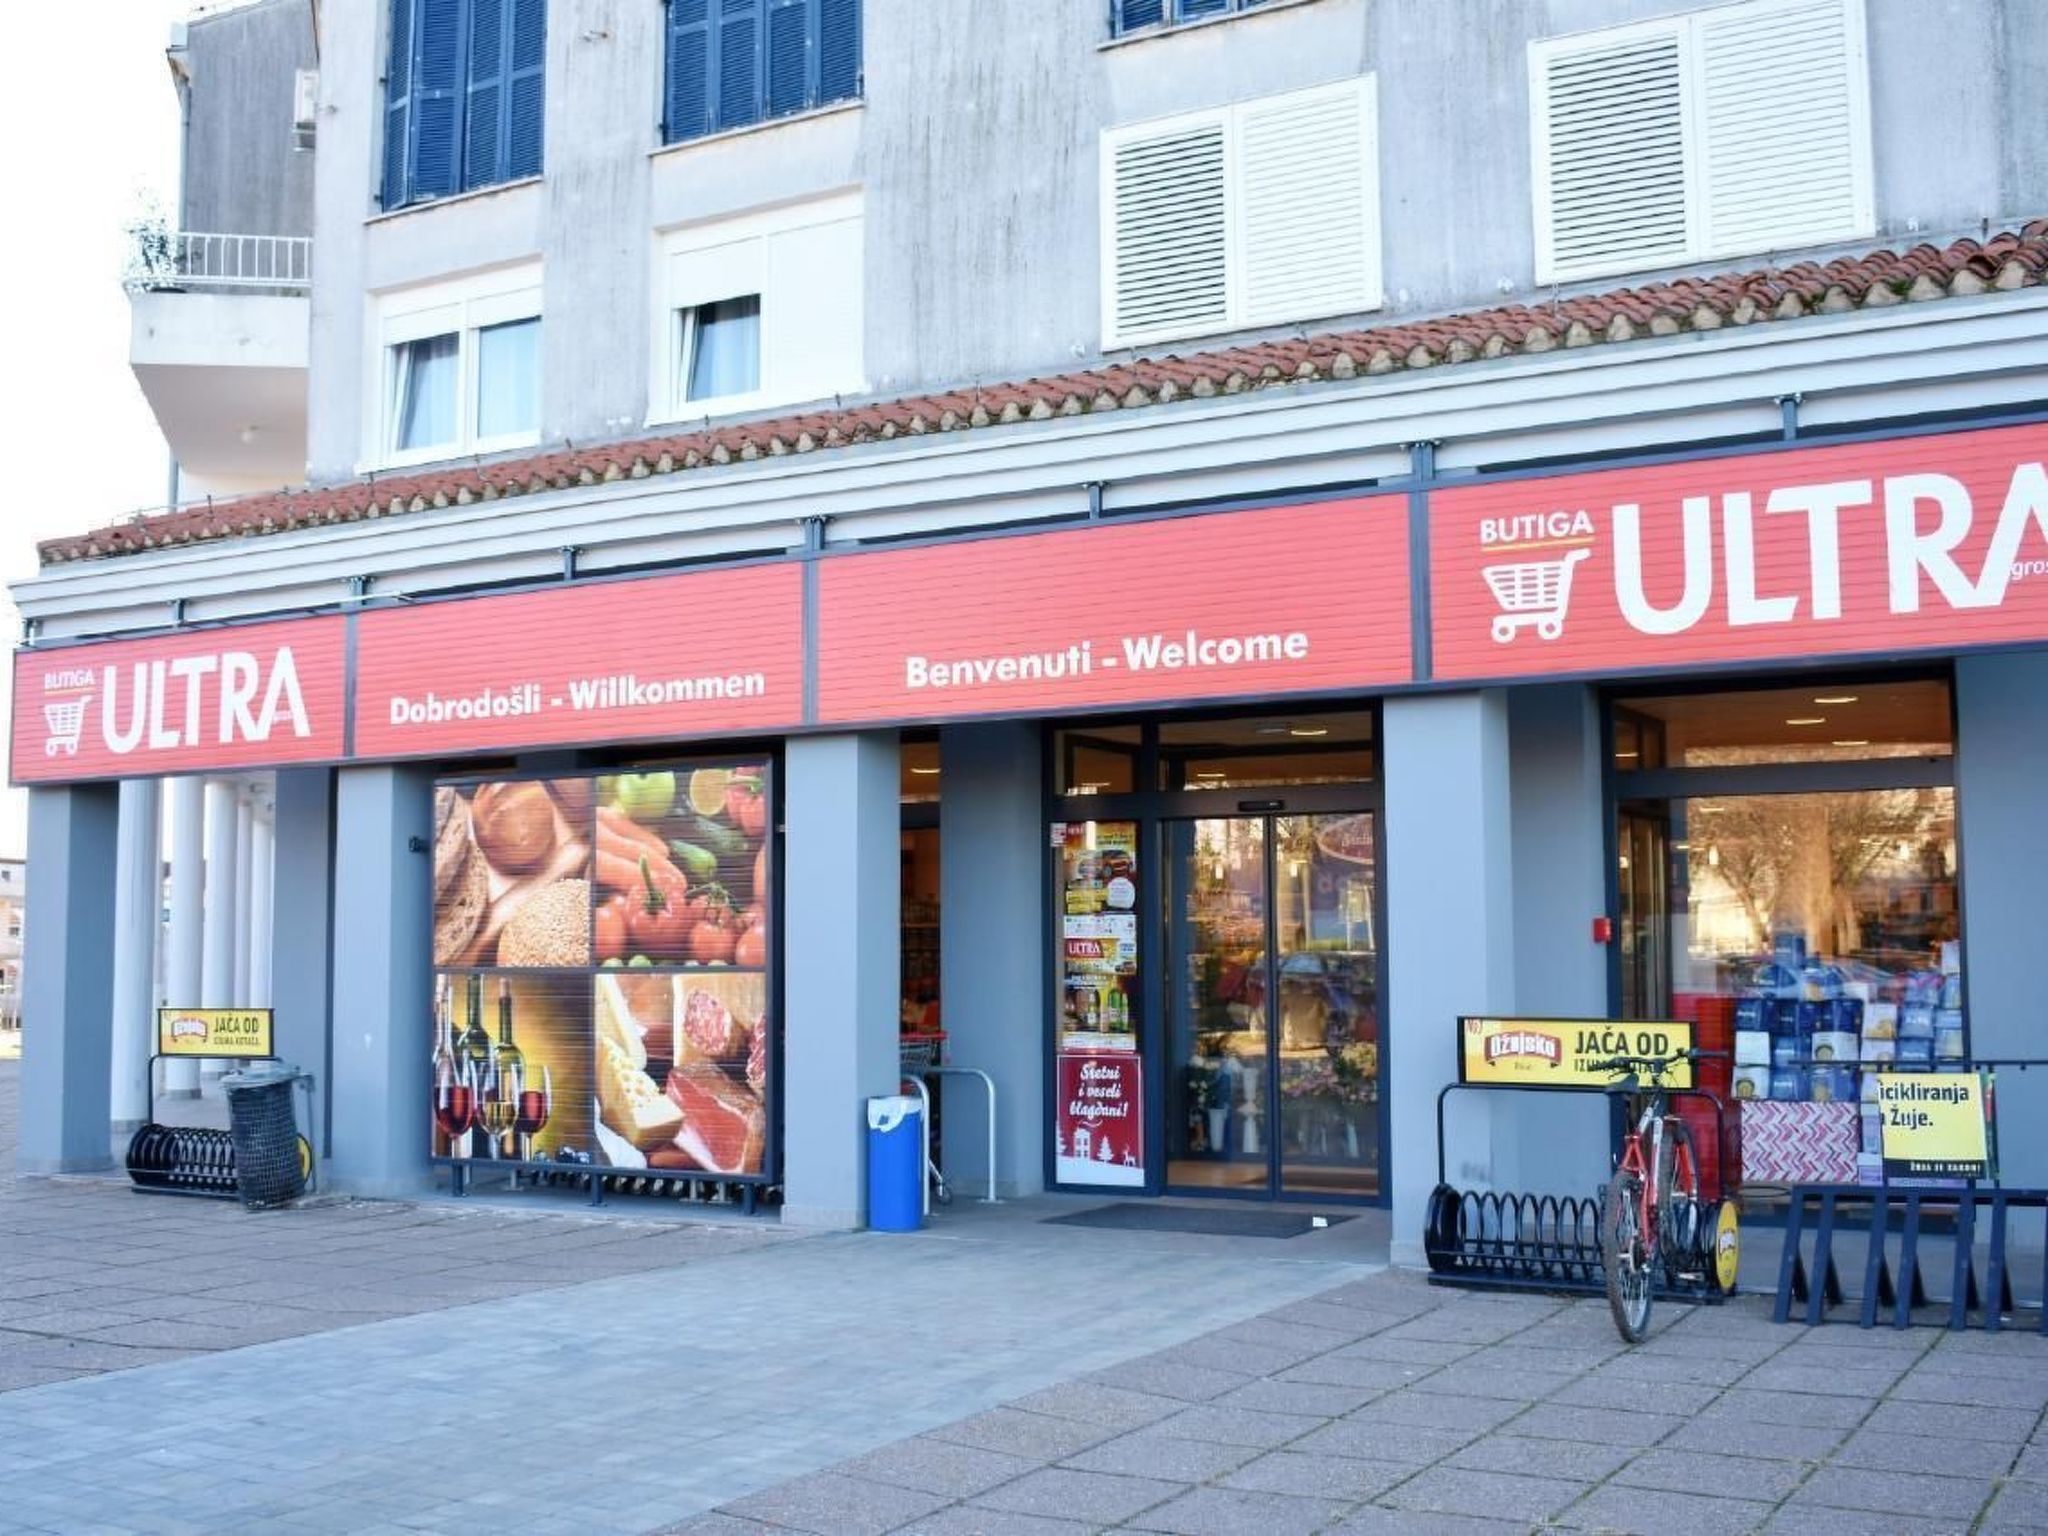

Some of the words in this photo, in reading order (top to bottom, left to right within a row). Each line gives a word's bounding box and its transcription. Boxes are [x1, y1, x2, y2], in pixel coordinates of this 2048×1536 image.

[1480, 510, 1595, 544] BUTIGA
[1611, 461, 2048, 635] ULTRA
[2009, 560, 2048, 581] gro
[906, 640, 1091, 689] Benvenuti
[1122, 629, 1309, 671] Welcome
[44, 669, 95, 689] BUTIGA
[102, 646, 311, 754] ULTRA
[390, 683, 541, 726] Dobrodošli
[569, 672, 765, 711] Willkommen
[213, 1013, 240, 1033] JAČA
[243, 1016, 260, 1034] OD
[1573, 1026, 1630, 1055] JAČA
[1636, 1031, 1669, 1056] OD
[1078, 1082, 1085, 1097] i
